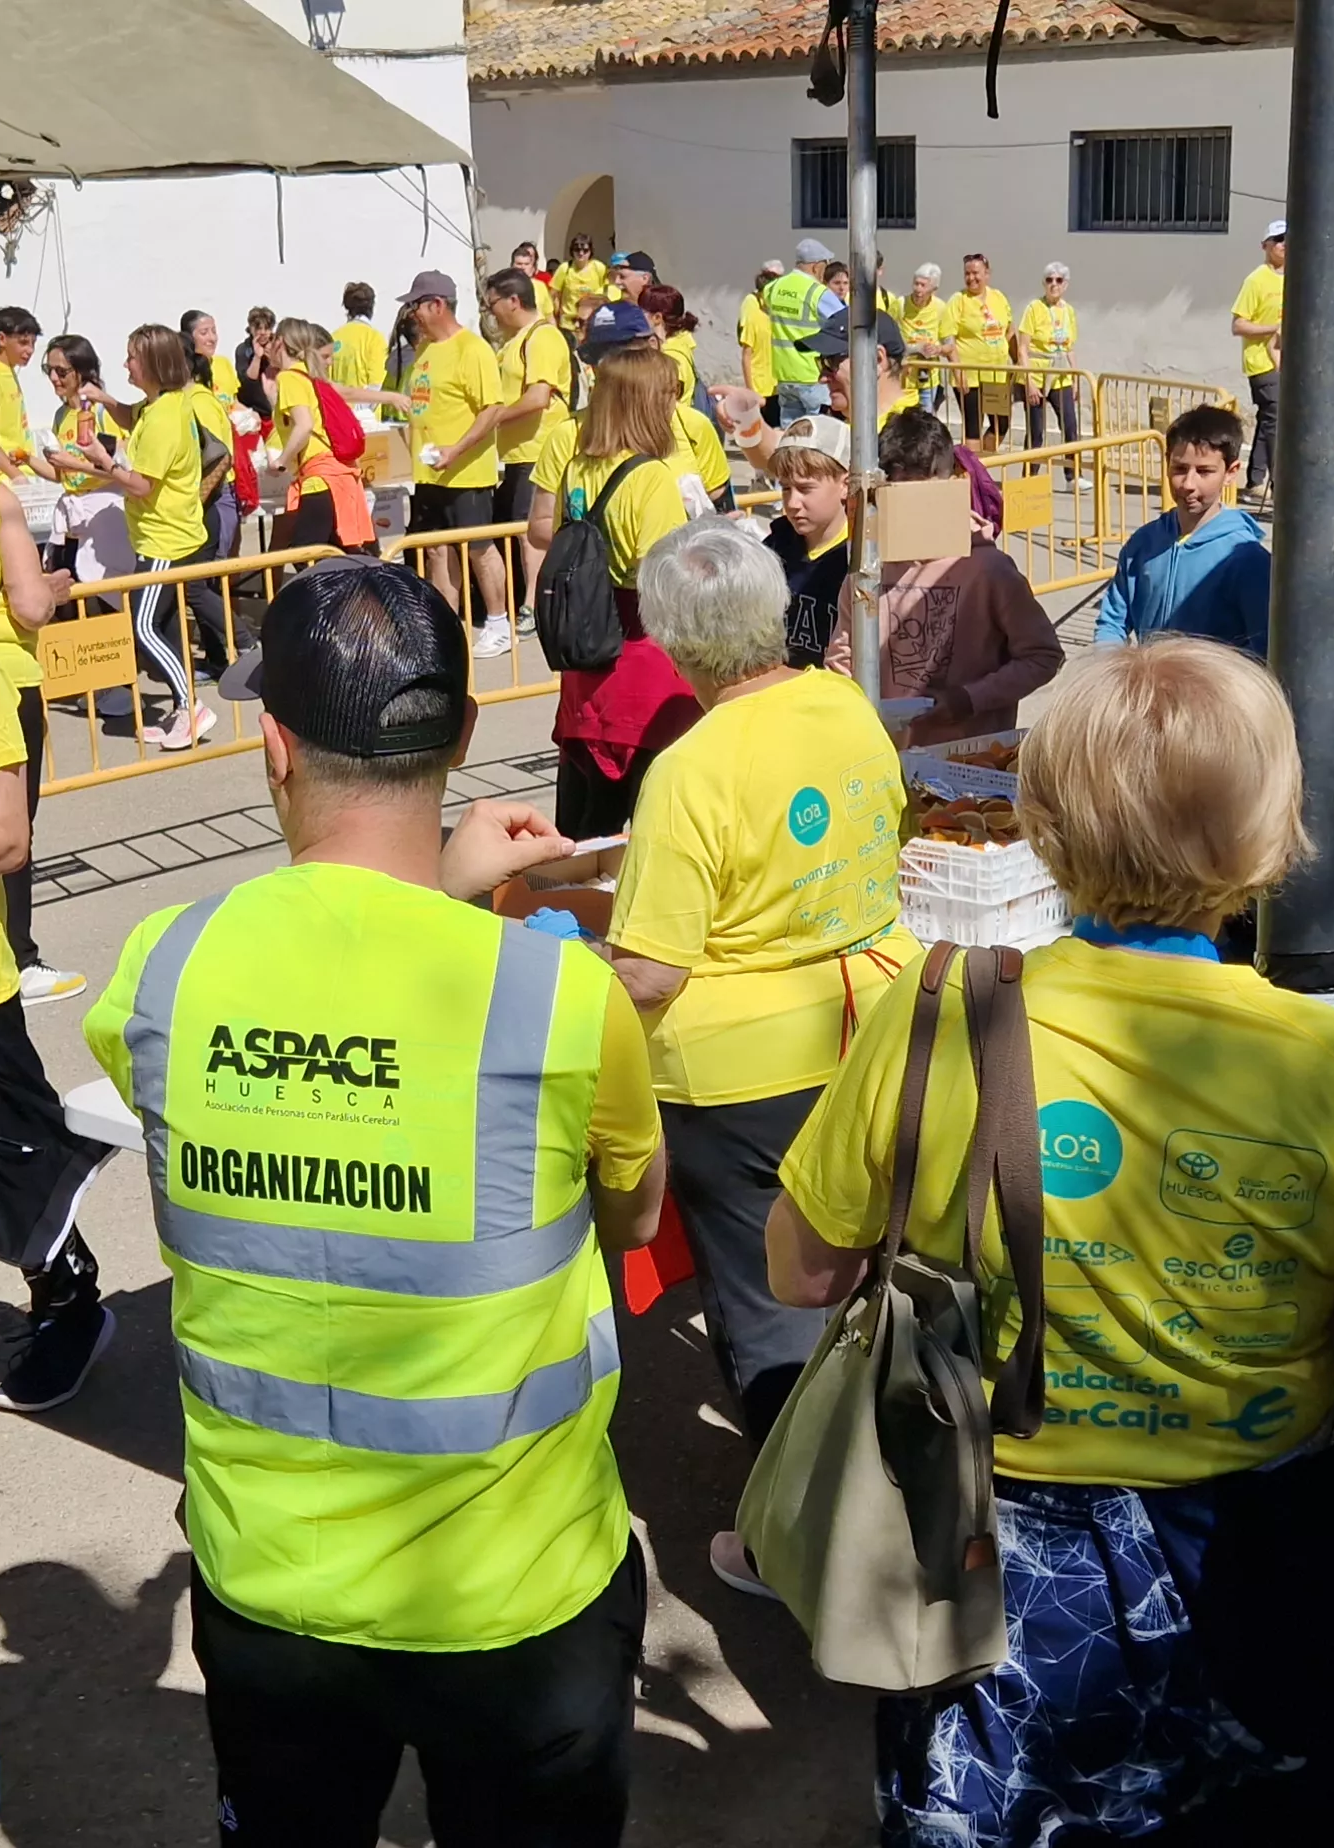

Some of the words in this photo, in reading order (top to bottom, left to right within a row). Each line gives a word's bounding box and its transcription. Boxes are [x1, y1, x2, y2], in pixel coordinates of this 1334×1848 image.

[76, 636, 132, 655] Ayuntamiento
[89, 651, 121, 665] Huesca
[206, 1024, 400, 1090] ASPACE
[205, 1100, 251, 1115] Asociación
[251, 1104, 264, 1115] de
[266, 1105, 306, 1119] Personas
[306, 1111, 324, 1120] con
[325, 1110, 360, 1124] Parálisis
[362, 1113, 400, 1127] Cerebral
[180, 1140, 432, 1214] ORGANIZACION
[1165, 1180, 1224, 1203] HUESCA
[1164, 1256, 1299, 1282] escanero
[1163, 1277, 1221, 1293] PLASTIC
[1044, 1366, 1180, 1399] ndación
[1043, 1401, 1191, 1436] erCaja
